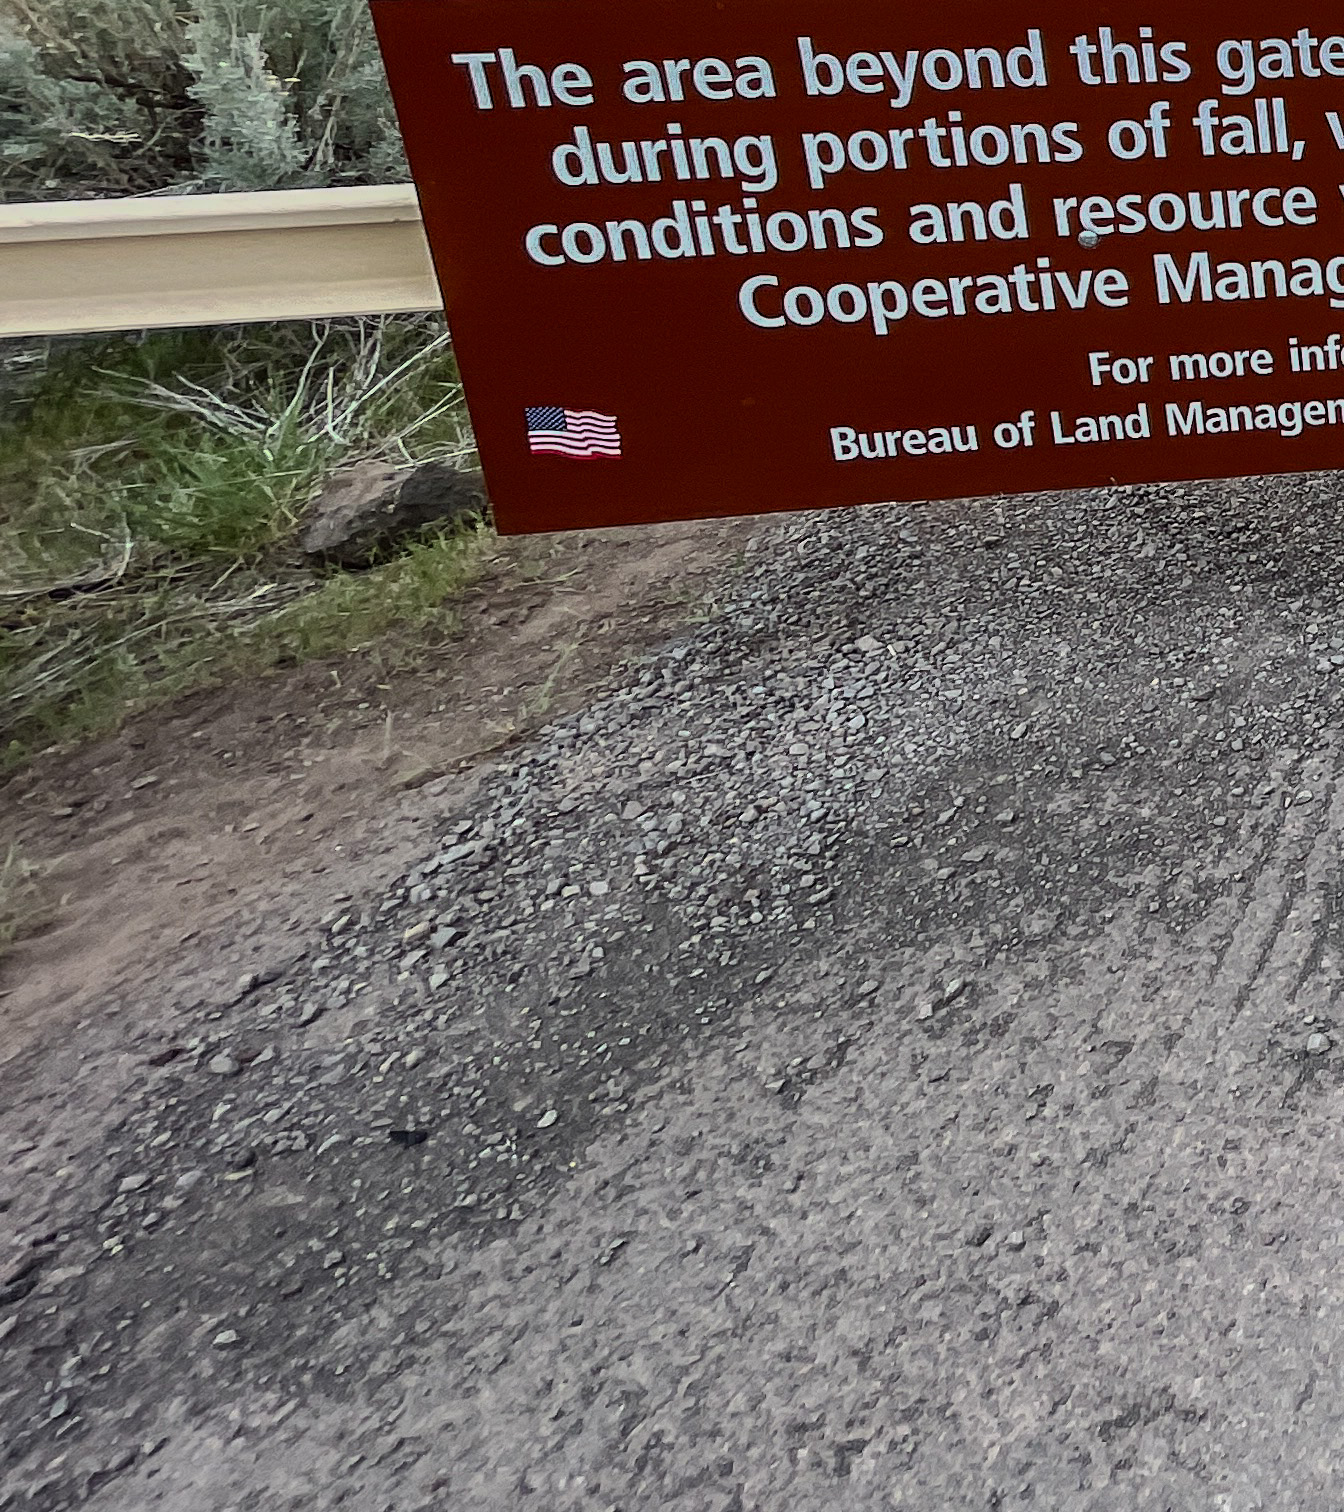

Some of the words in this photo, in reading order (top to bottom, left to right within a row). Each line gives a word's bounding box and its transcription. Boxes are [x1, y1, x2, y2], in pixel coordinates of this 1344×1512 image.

[450, 47, 595, 110] The
[622, 56, 777, 103] area
[797, 28, 1048, 109] beyond
[1069, 26, 1192, 85] this
[552, 122, 778, 192] during
[801, 110, 1083, 189] portions
[1108, 100, 1171, 160] of
[1192, 97, 1306, 161] fall,
[525, 197, 884, 266] conditions
[909, 183, 1029, 244] and
[1052, 186, 1318, 238] resource
[738, 256, 1129, 336] Cooperative
[1088, 351, 1154, 386] For
[1169, 349, 1274, 381] more
[829, 425, 979, 461] Bureau
[993, 410, 1036, 448] of
[1050, 402, 1151, 445] Land
